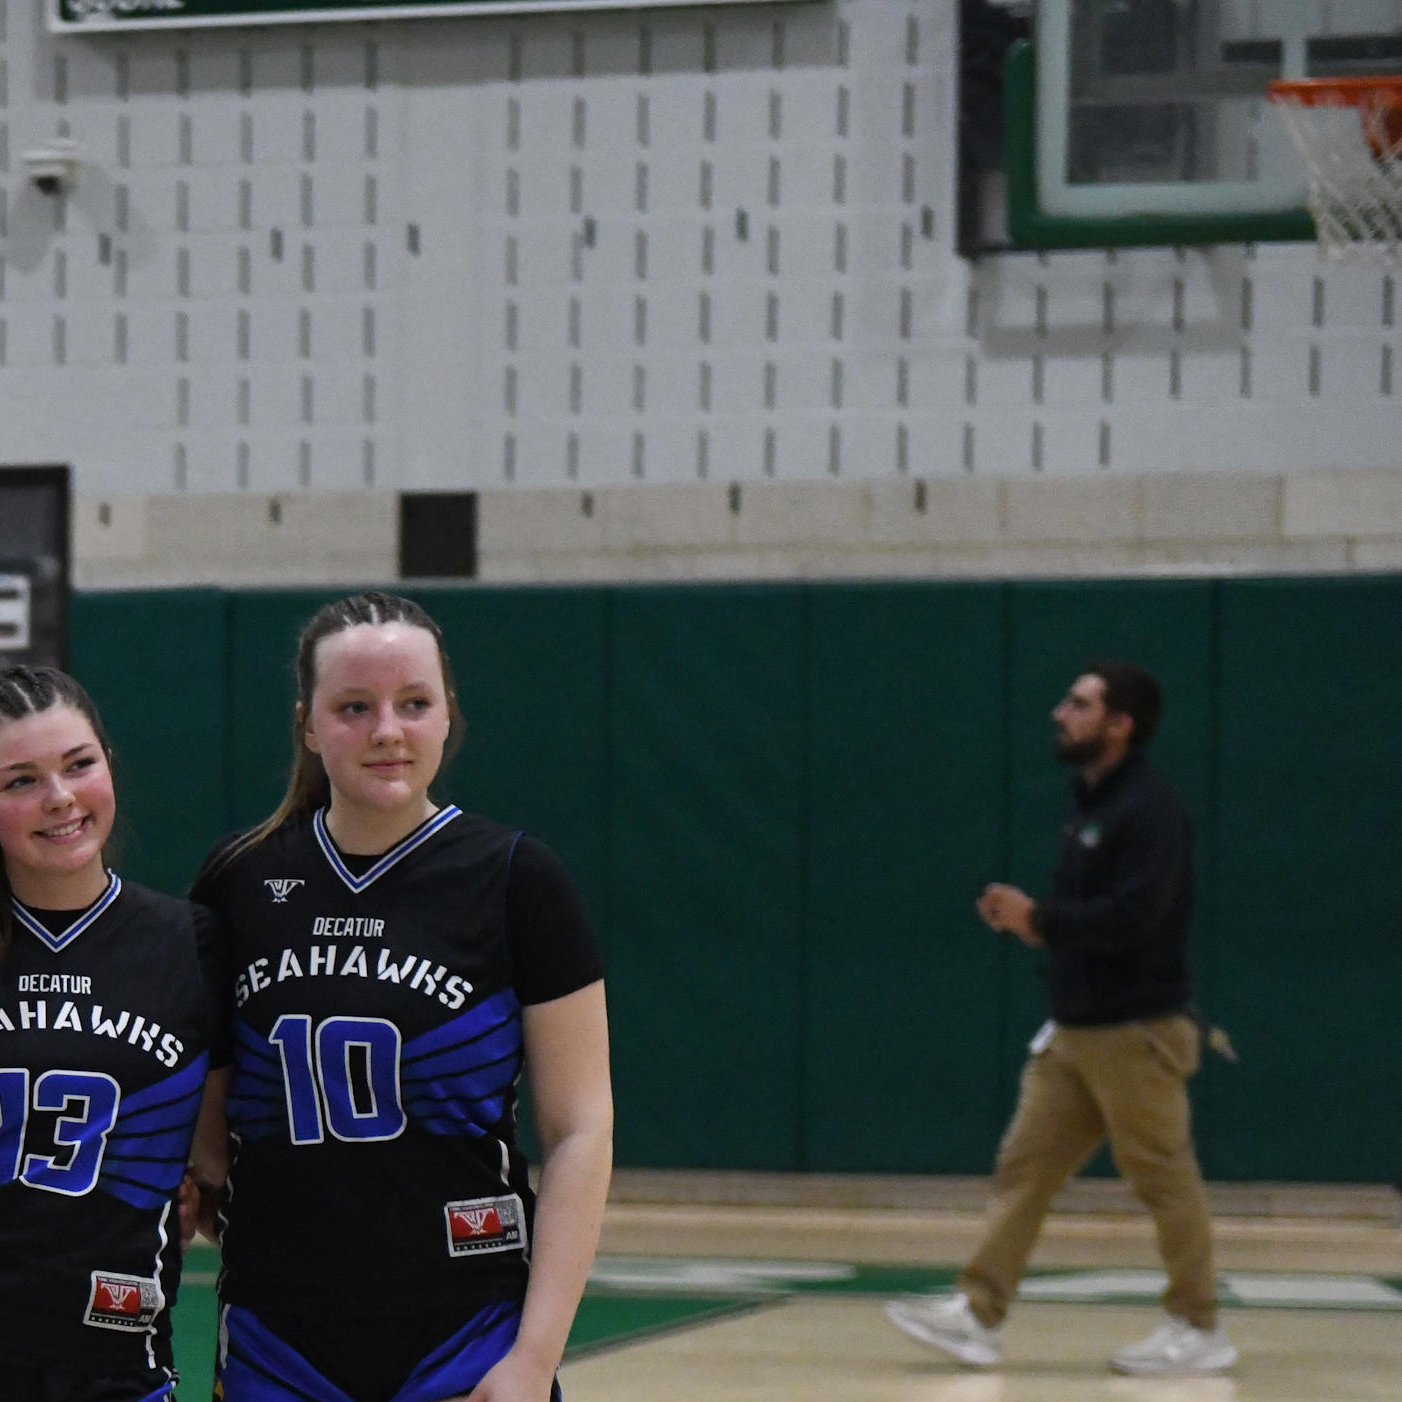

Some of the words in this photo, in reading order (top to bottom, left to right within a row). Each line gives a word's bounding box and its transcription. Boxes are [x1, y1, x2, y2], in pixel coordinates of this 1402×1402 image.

[313, 917, 385, 938] DECATUR
[19, 974, 92, 995] DECATUR
[235, 945, 474, 1010] SEAHAWKS
[268, 1014, 408, 1146] 10
